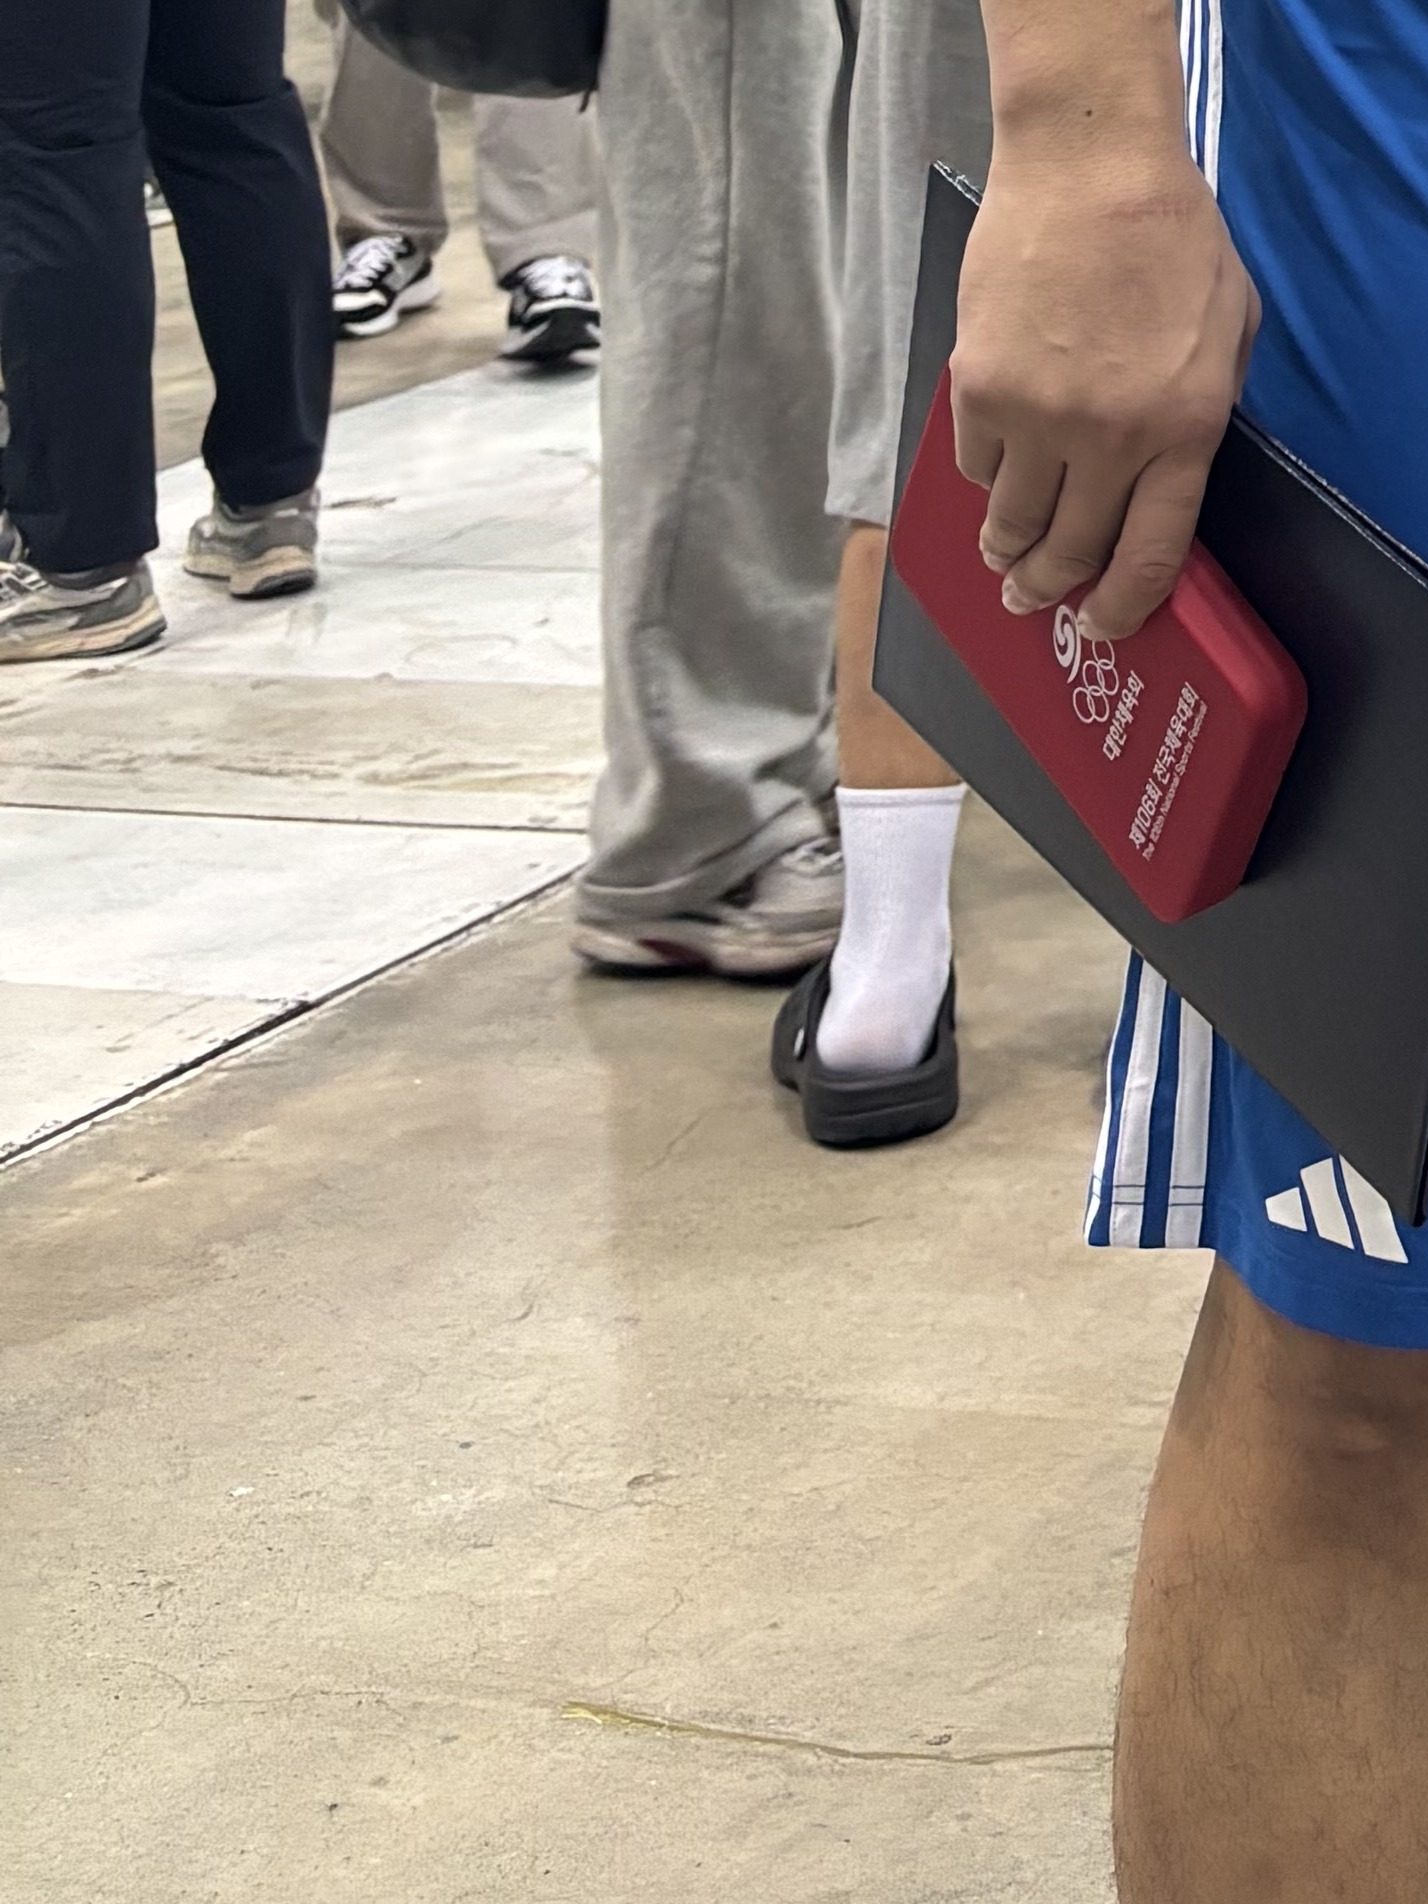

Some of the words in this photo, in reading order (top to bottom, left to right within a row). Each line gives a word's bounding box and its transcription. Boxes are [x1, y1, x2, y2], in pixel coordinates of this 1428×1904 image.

[1103, 670, 1145, 761] 대한체육회
[1128, 778, 1163, 849] 제106회
[1153, 681, 1200, 784] 전국체육대회
